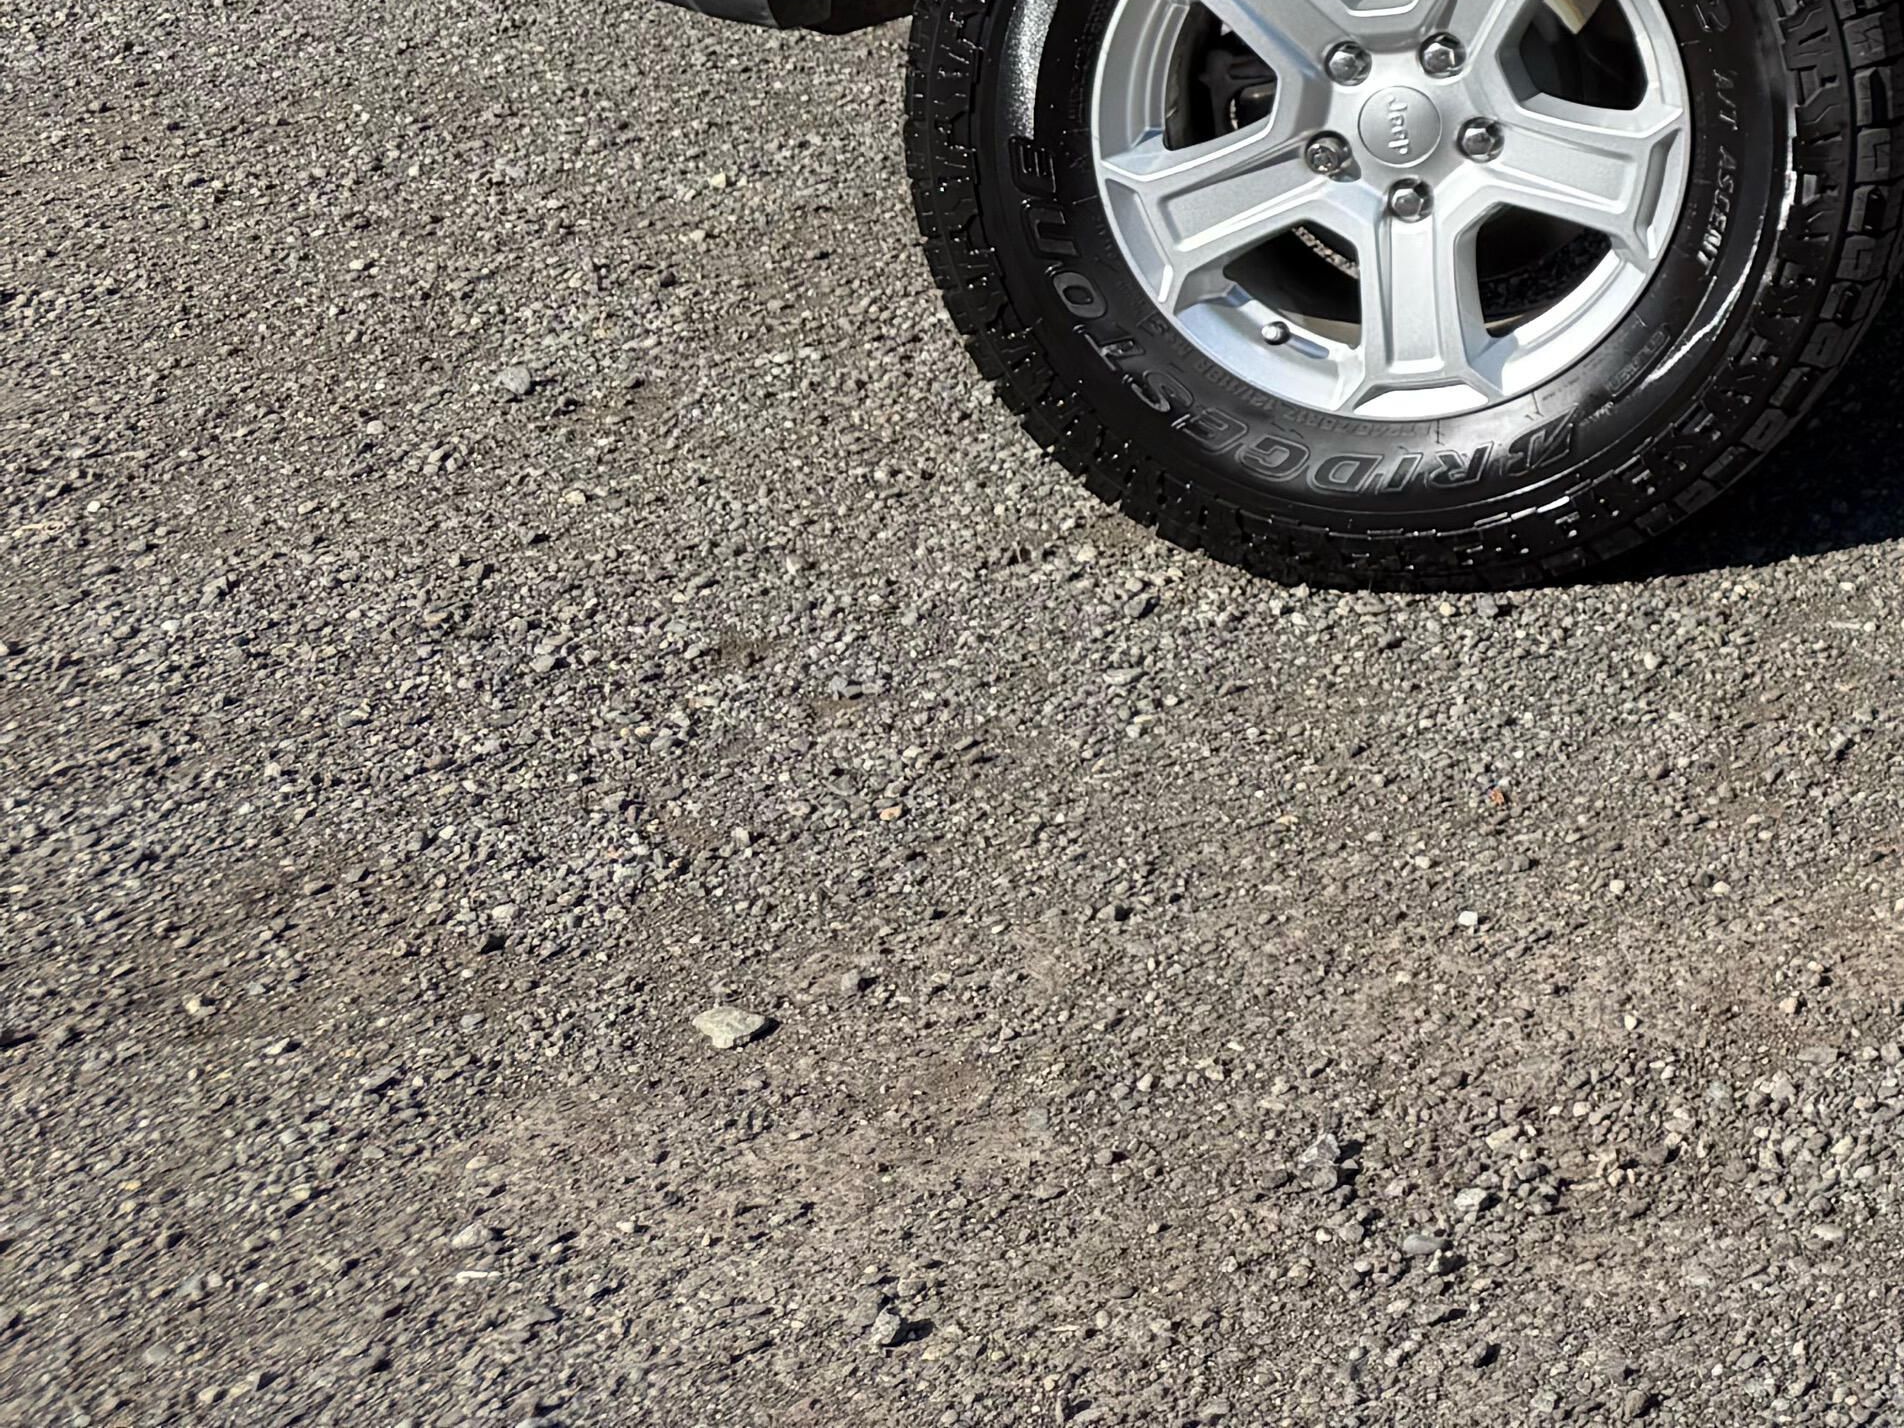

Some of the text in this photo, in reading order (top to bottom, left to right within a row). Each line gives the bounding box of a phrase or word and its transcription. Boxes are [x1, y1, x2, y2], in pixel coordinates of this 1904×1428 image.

[1384, 94, 1410, 156] Jeep
[1695, 144, 1740, 276] ASCENT
[1012, 140, 1586, 496] BRIDGESTONE
